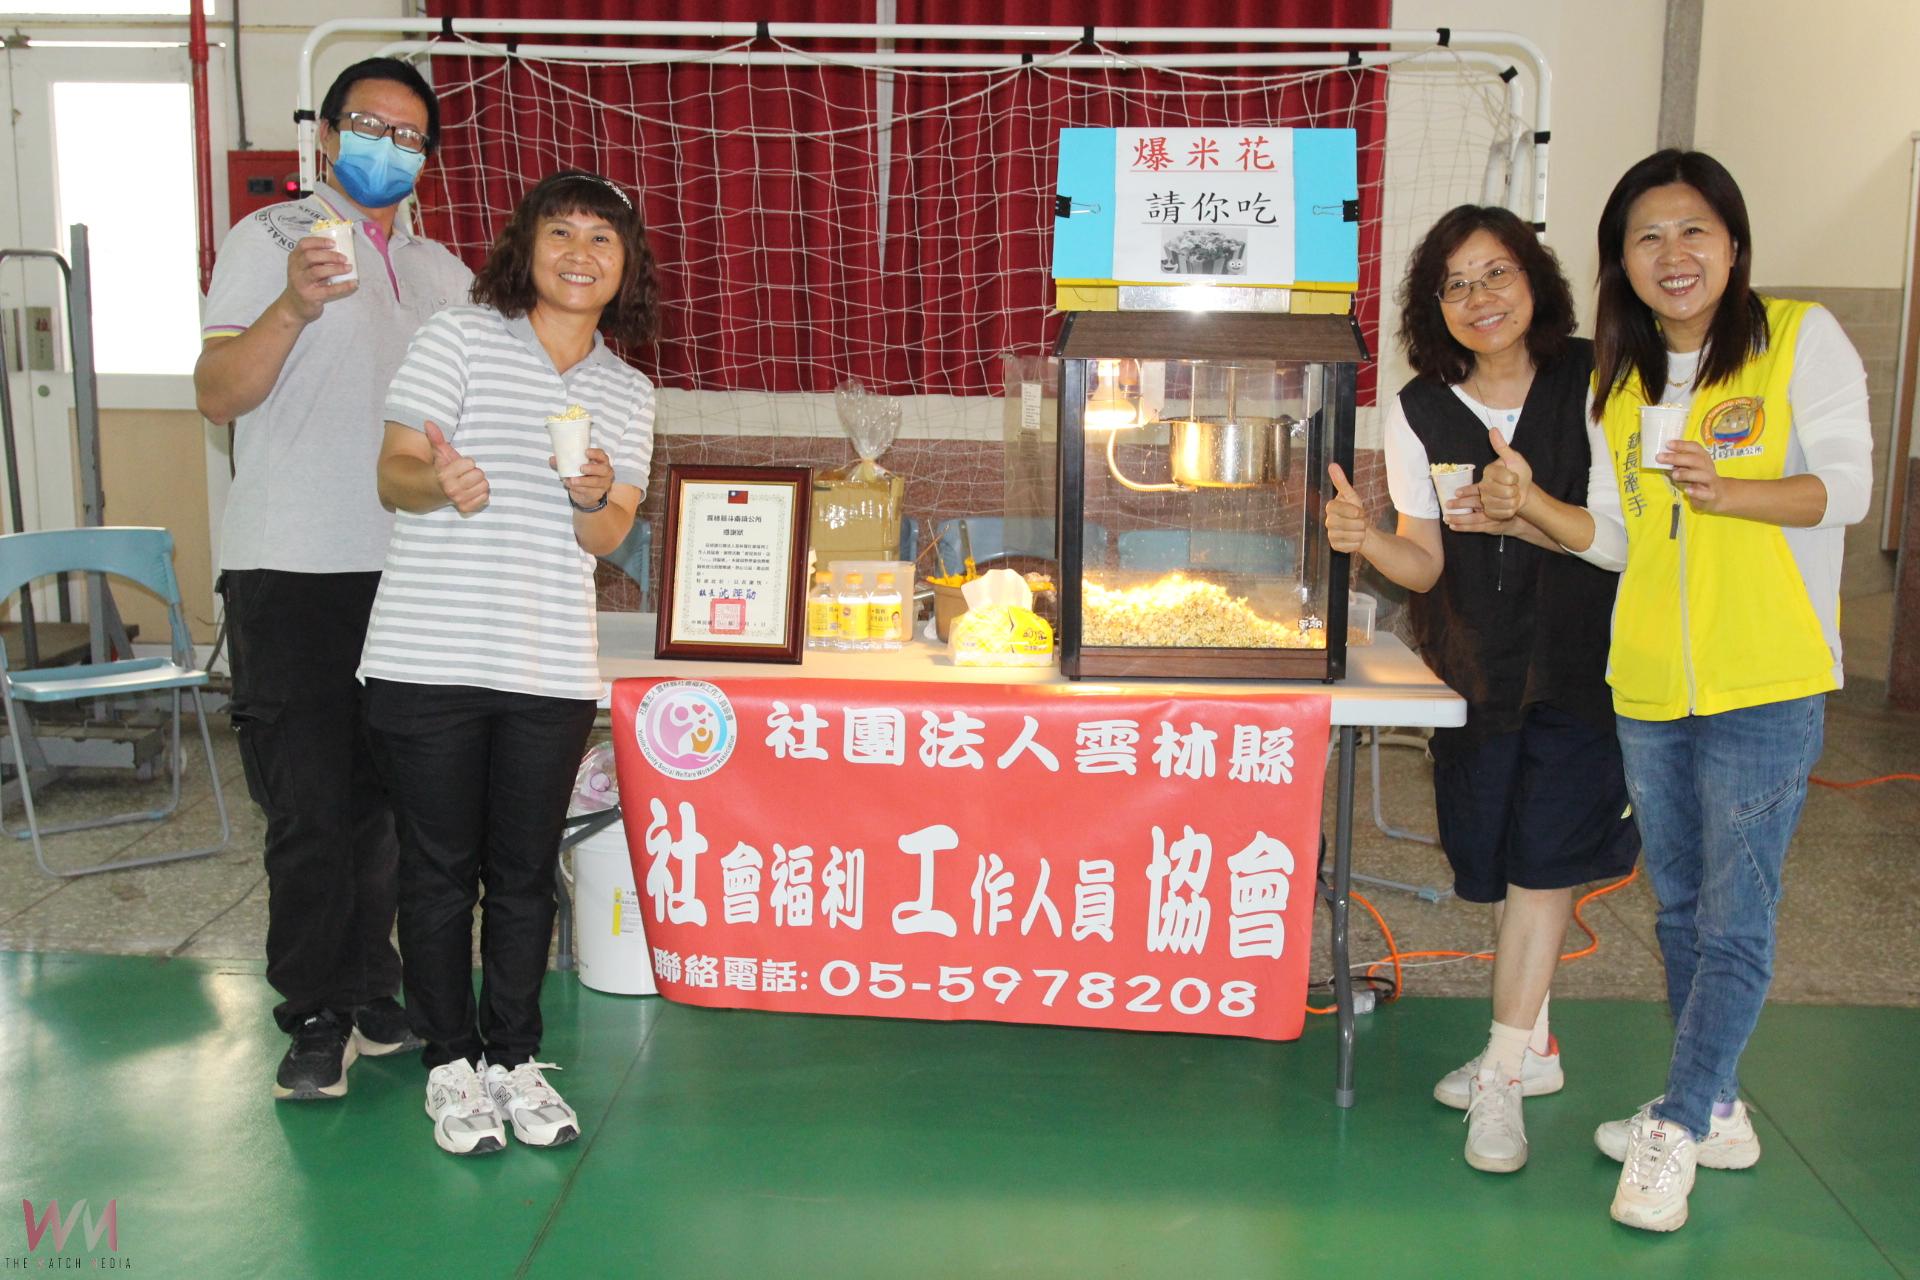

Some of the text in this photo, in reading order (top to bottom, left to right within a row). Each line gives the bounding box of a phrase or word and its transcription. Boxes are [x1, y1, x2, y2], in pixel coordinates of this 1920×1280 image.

[1132, 136, 1277, 171] 爆米花
[1145, 191, 1277, 225] 請你吃
[765, 701, 1295, 785] 社團法人雲林縣
[643, 747, 658, 766] County
[658, 762, 675, 775] Social
[675, 769, 696, 778] Welfare
[697, 762, 719, 776] Workers
[646, 798, 1295, 960] 社會福利工作人員協會
